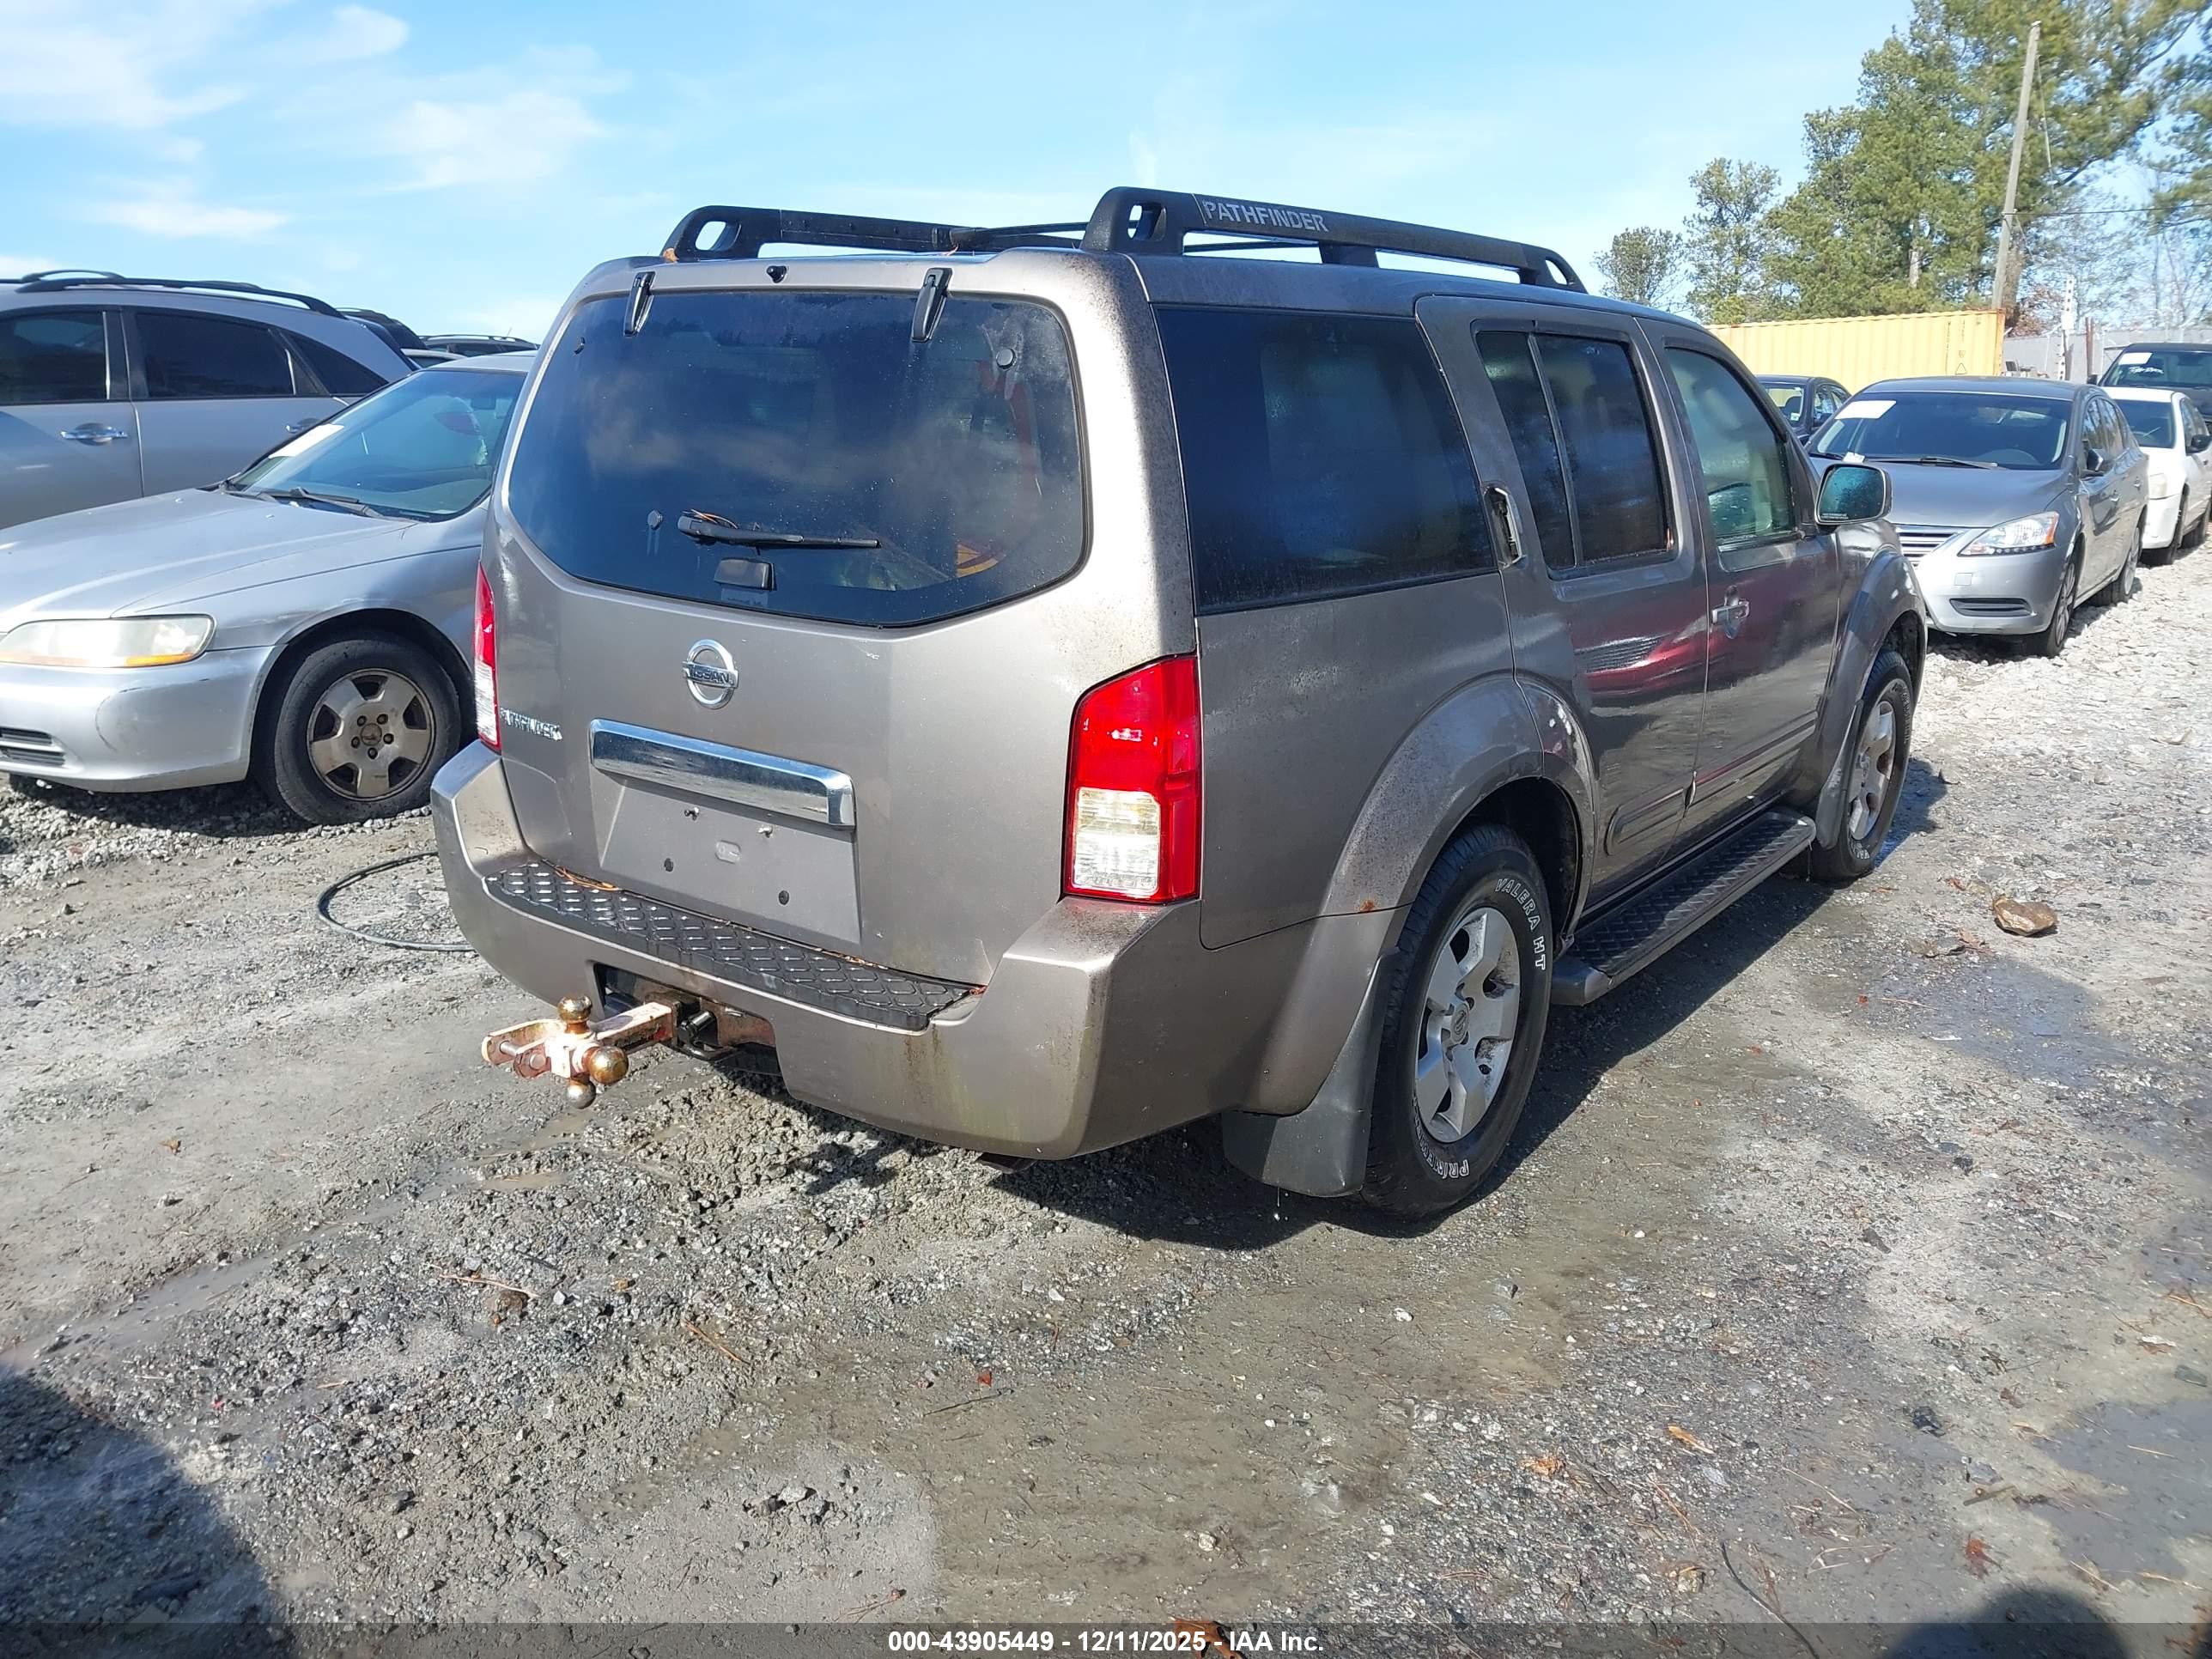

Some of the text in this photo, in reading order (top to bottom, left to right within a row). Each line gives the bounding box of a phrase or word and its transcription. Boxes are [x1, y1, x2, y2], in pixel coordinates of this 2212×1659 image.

[1202, 199, 1329, 232] PATHFINDER
[1495, 878, 1547, 971] VALERA HT
